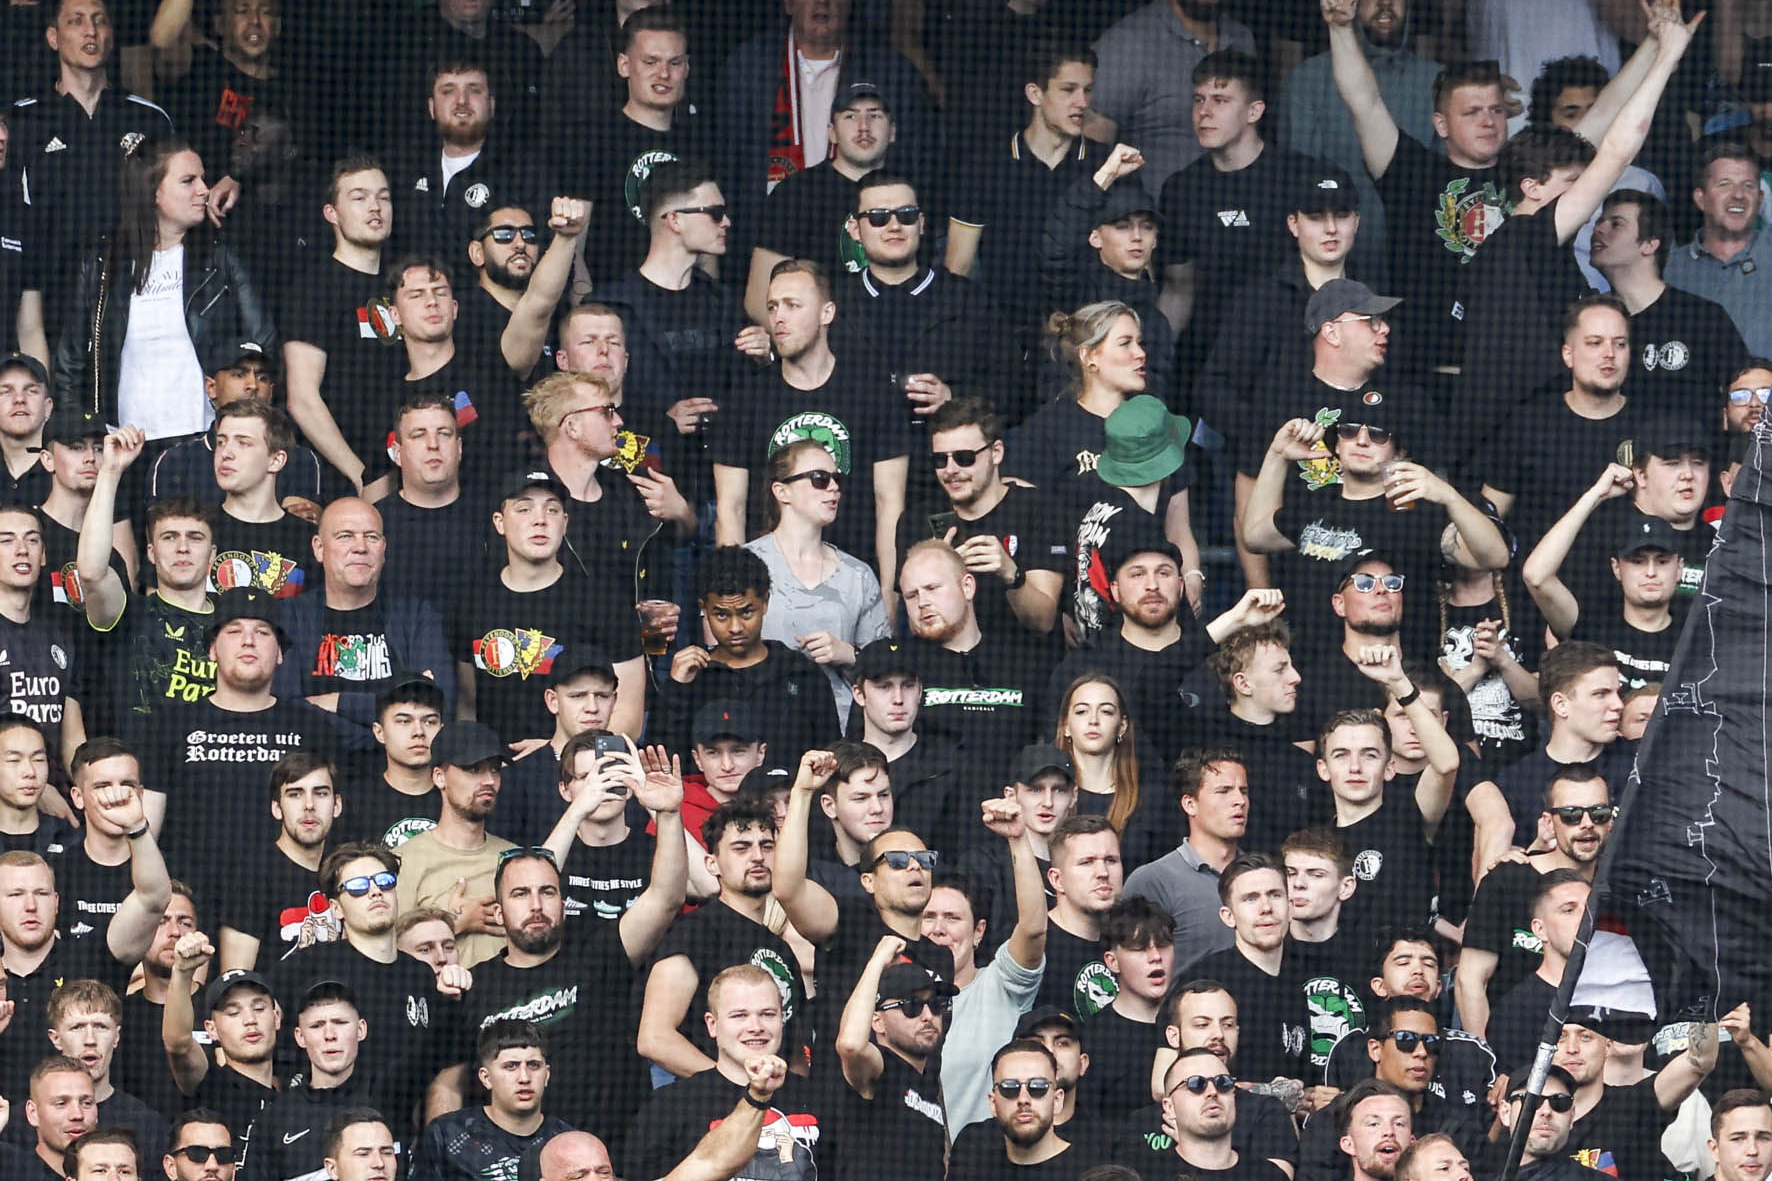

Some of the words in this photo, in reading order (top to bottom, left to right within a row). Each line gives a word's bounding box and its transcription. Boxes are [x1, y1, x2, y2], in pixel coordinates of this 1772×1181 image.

[774, 414, 849, 447] ROTTERDAM
[173, 648, 219, 679] Eur
[10, 671, 60, 698] Euro
[165, 673, 217, 703] Par
[924, 689, 1023, 706] ROTTERDAM
[187, 730, 268, 746] Groeten
[275, 730, 302, 746] uit
[185, 745, 287, 763] Rotterda
[620, 878, 643, 889] STYLE
[1143, 1132, 1173, 1151] YOU
